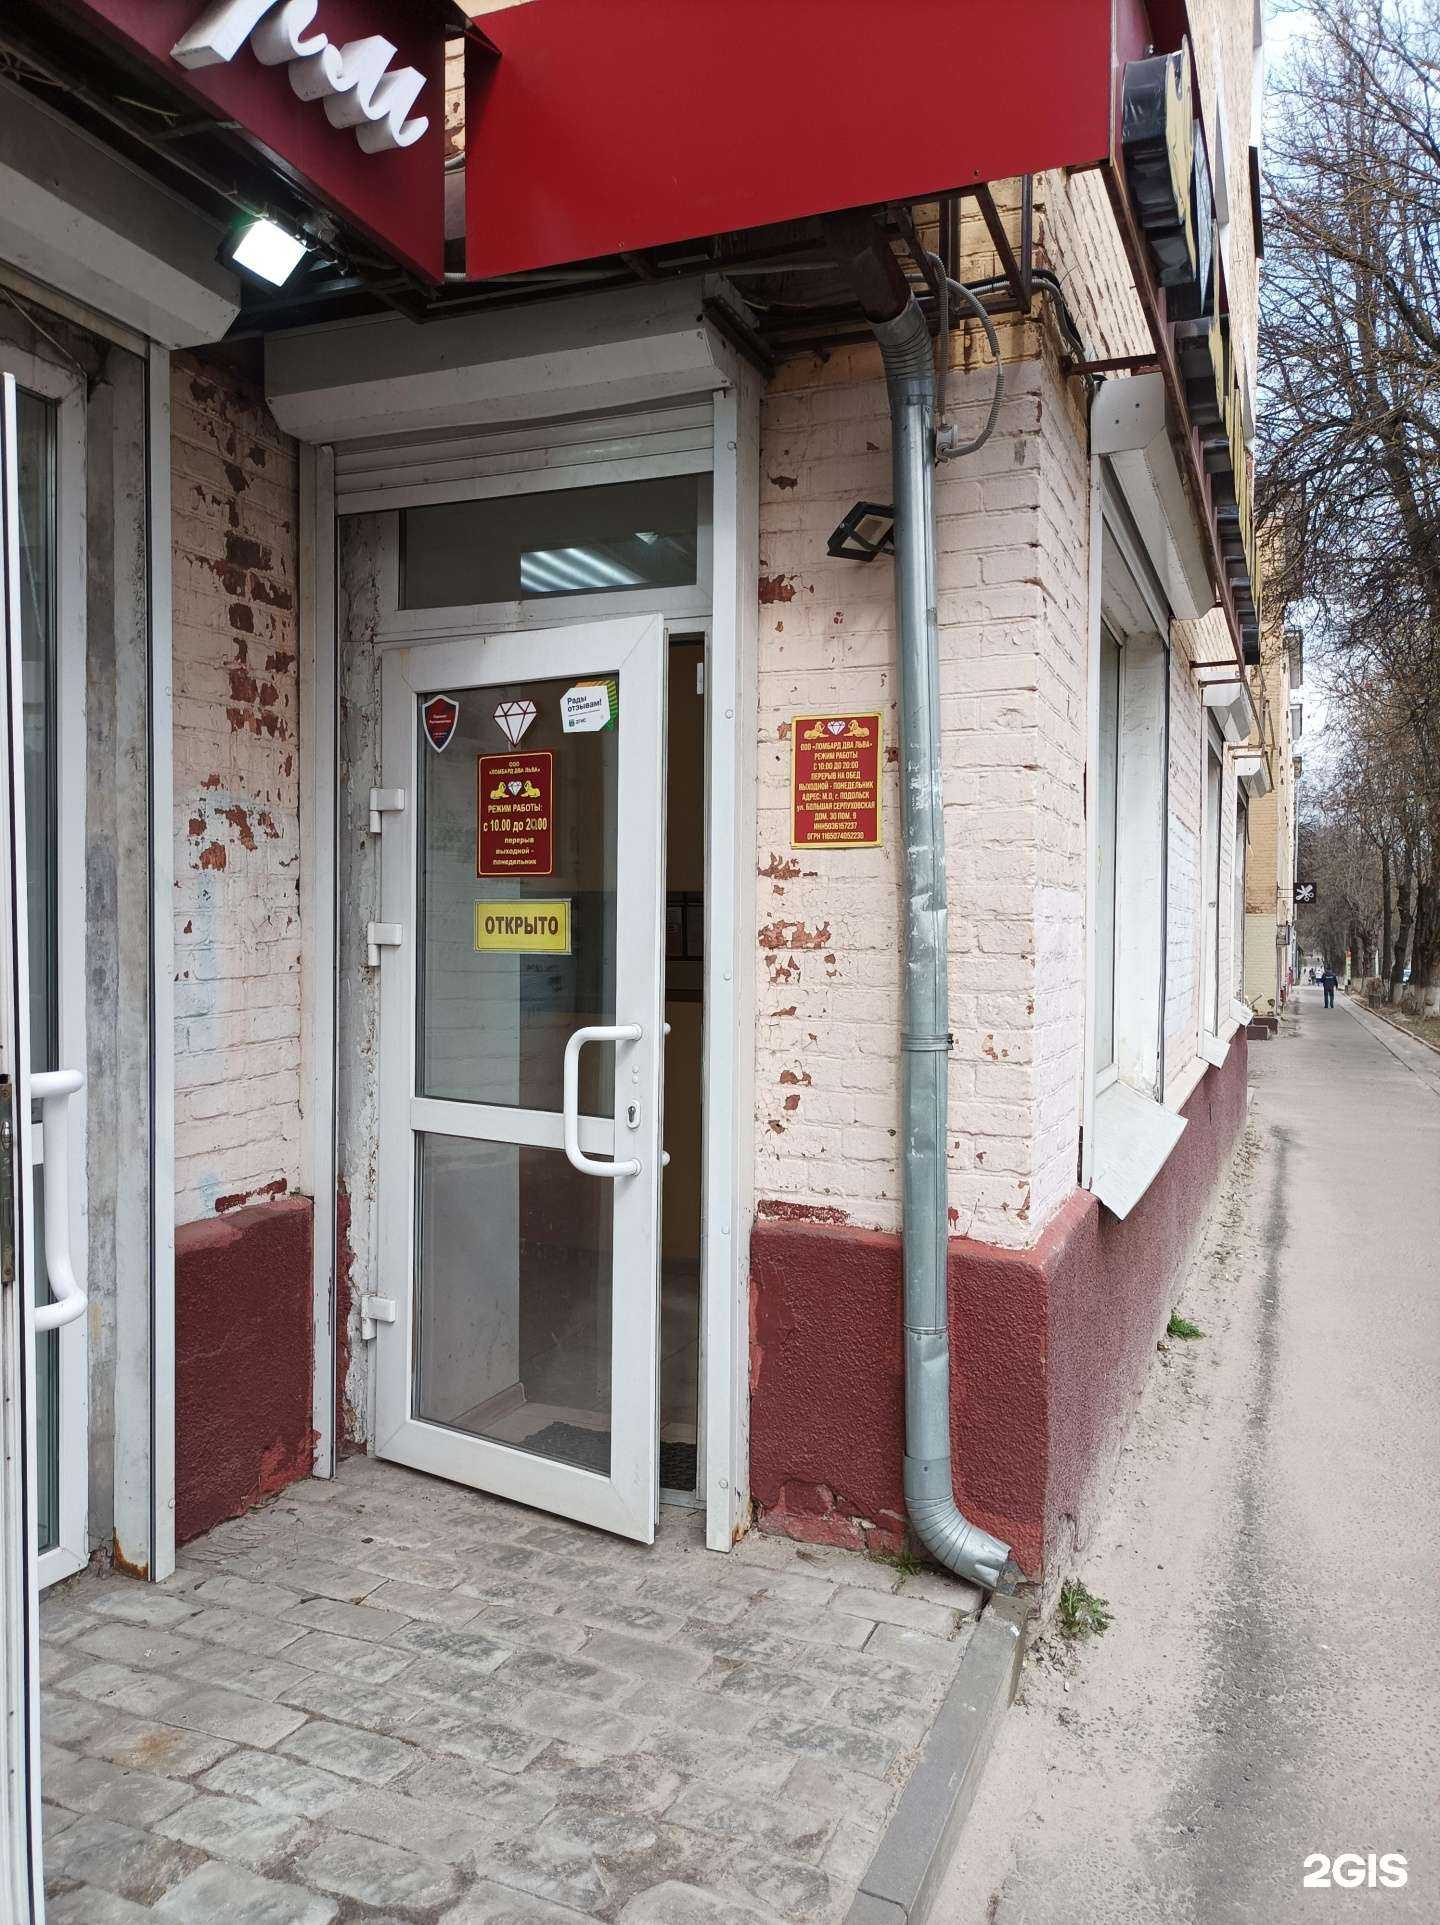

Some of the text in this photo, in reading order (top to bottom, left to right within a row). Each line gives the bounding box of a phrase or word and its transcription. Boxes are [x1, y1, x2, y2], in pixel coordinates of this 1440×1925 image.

[567, 696, 587, 705] Рады
[567, 698, 602, 712] отзывам!
[800, 743, 811, 751] ООО
[842, 741, 854, 750] ДВА
[814, 751, 858, 760] РЕЖИМ РАБОТЫ
[833, 762, 842, 770] ДО
[811, 771, 861, 780] ПЕРЕРЫВ НА ОБЕД
[798, 781, 829, 790] ВЫХОДНОЙ
[833, 780, 874, 790] ПОНЕДЕЛЬНИК
[839, 791, 870, 800] ПОДОЛЬСК
[488, 803, 543, 813] РЕЖИМ РАБОТЫ:
[805, 802, 833, 811] БОЛЬШАЯ
[833, 801, 876, 810] СЕРПУХОВСКАЯ
[830, 812, 837, 820] 30
[483, 818, 547, 833] с 10.00 до 20.00
[504, 837, 535, 845] перерыв
[806, 833, 820, 841] ОГРН
[495, 847, 530, 855] выходной
[485, 916, 559, 935] ОТКРЫТО
